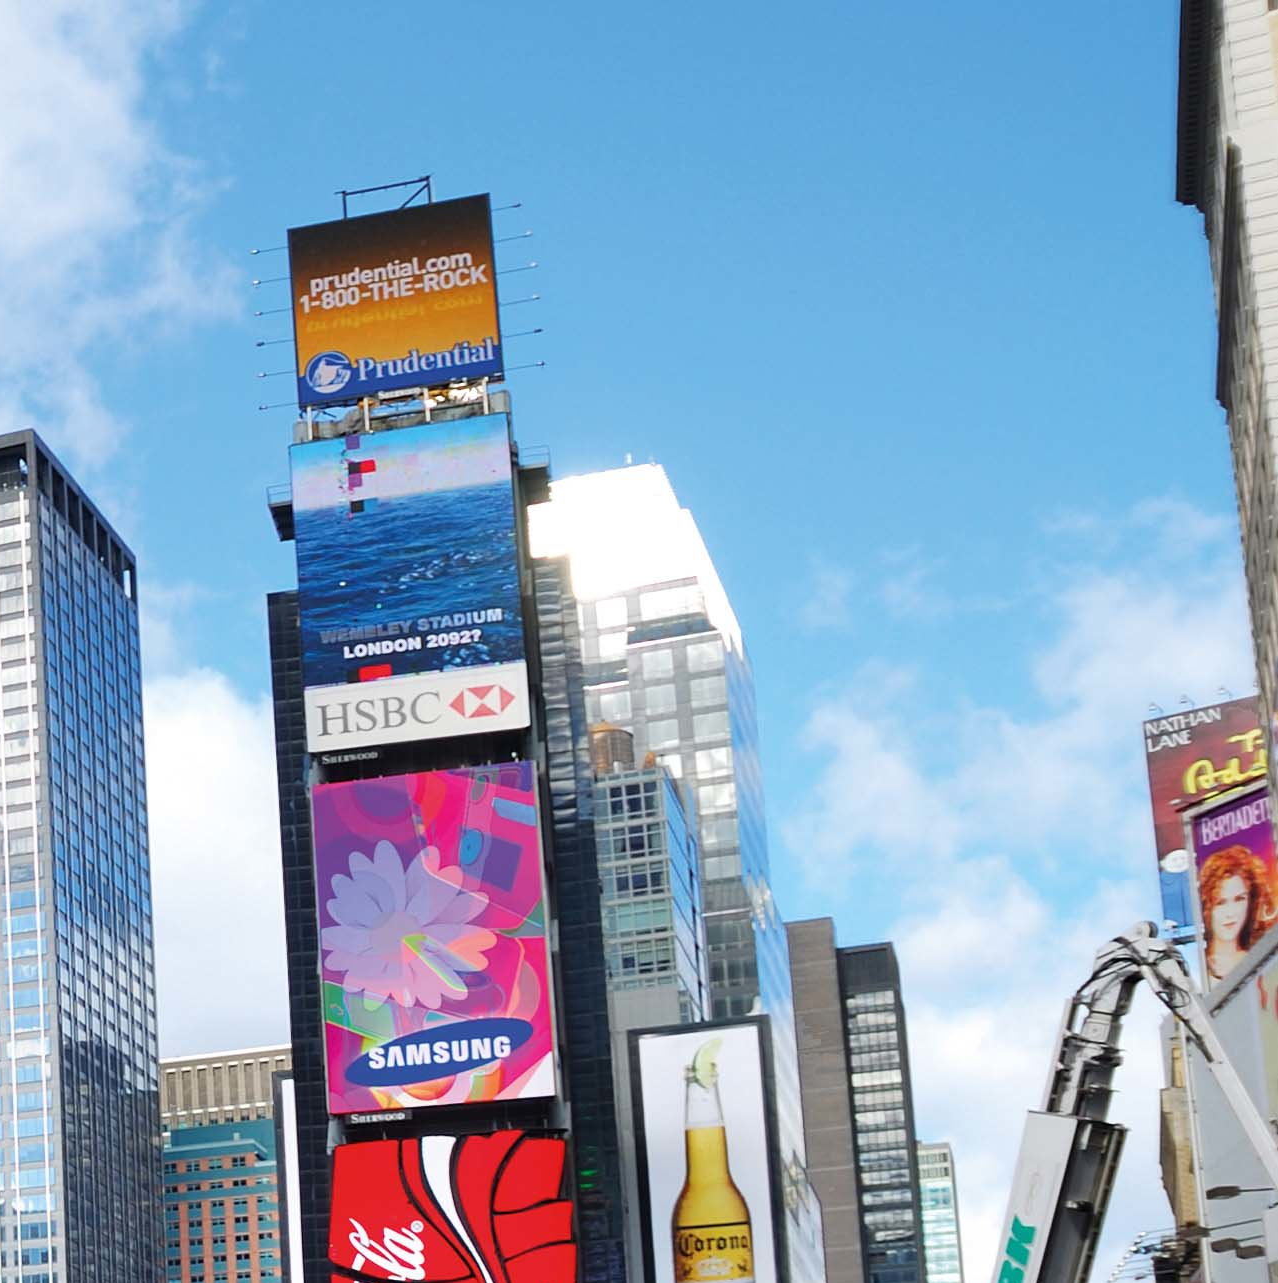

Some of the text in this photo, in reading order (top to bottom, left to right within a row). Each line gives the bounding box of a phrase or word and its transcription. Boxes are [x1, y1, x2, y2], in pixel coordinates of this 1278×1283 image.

[299, 265, 488, 314] 1-800-THE-ROCK
[310, 252, 472, 297] prudential.com
[357, 337, 495, 382] Prudential
[417, 608, 502, 632] STADIUM
[343, 629, 482, 659] LONDON 2092?
[316, 691, 444, 737] HSBC
[1145, 707, 1221, 736] NATHAN
[1147, 729, 1191, 752] LANE
[368, 1035, 511, 1070] SAMSUNG
[678, 1232, 749, 1257] Corona
